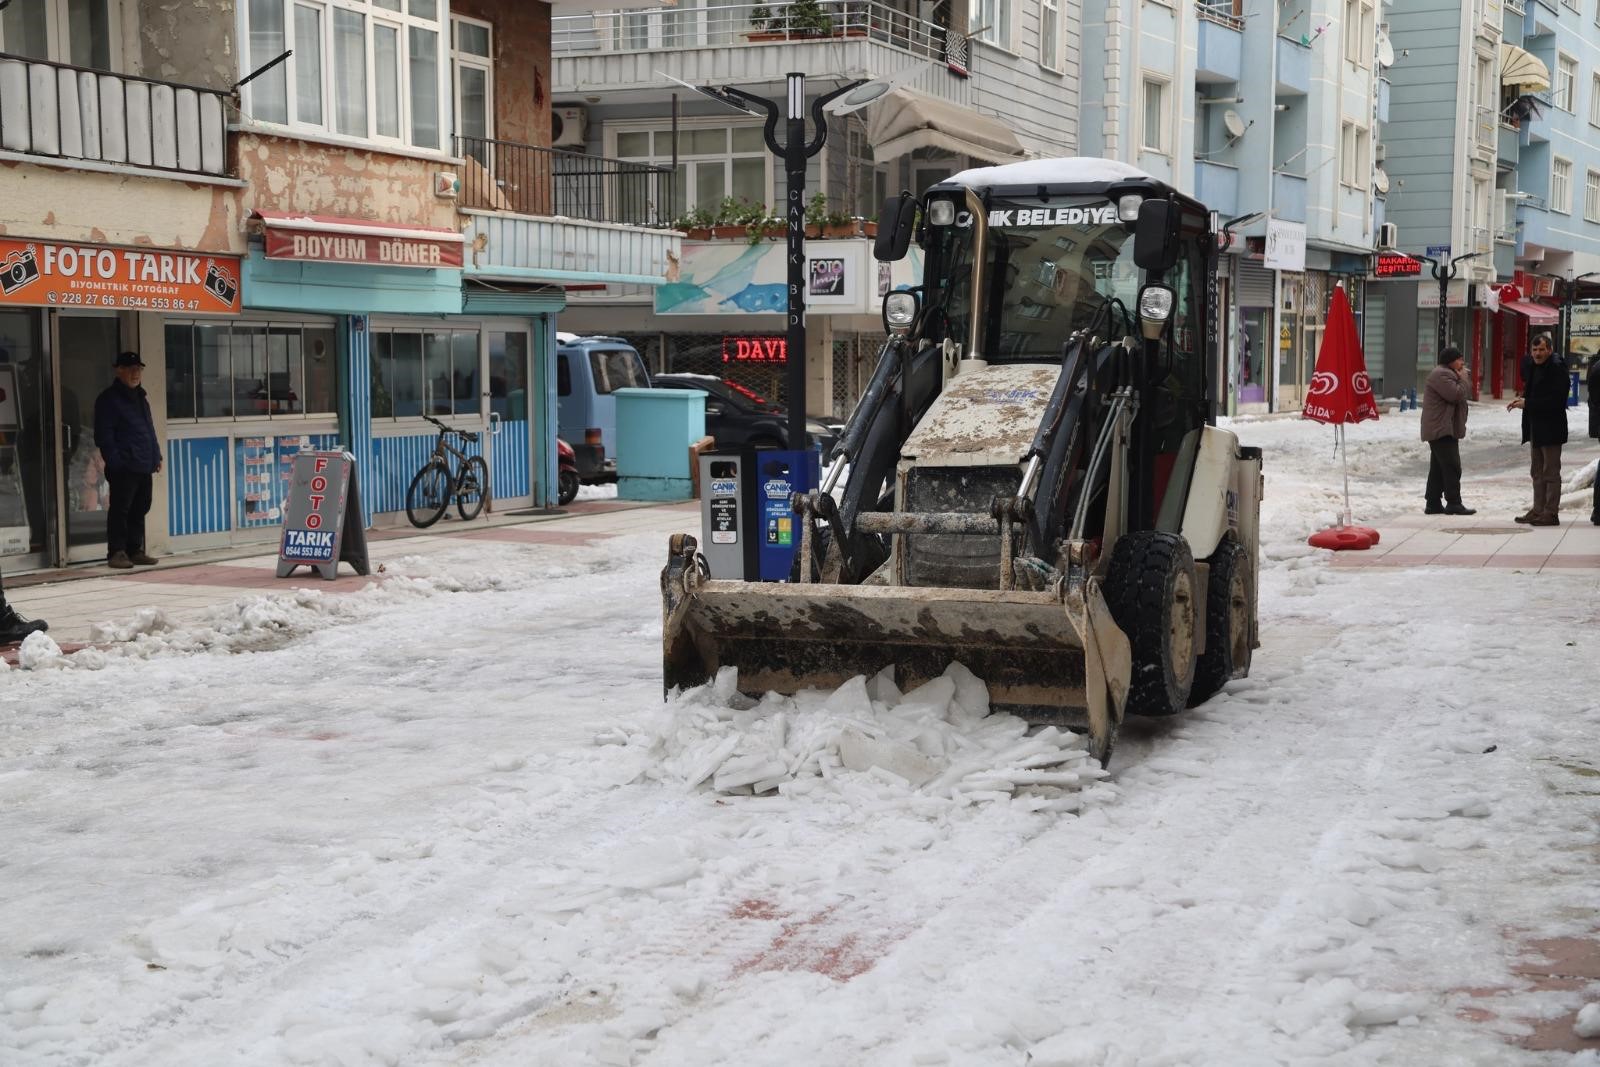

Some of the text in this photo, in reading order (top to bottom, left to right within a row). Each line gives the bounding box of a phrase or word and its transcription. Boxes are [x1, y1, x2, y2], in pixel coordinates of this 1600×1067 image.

[293, 234, 441, 265] DOYUM DÖNER
[43, 245, 202, 285] FOTO TARIK
[811, 260, 843, 274] FOTO
[131, 284, 180, 294] FOTOĞRAF
[61, 292, 200, 310] 228 27 66 0544 553 86 47
[789, 284, 799, 325] BLD
[1304, 403, 1331, 419] GIDA
[305, 457, 328, 529] FOTO
[287, 530, 333, 547] TARIK
[285, 546, 332, 558] 0544 553 86 47
